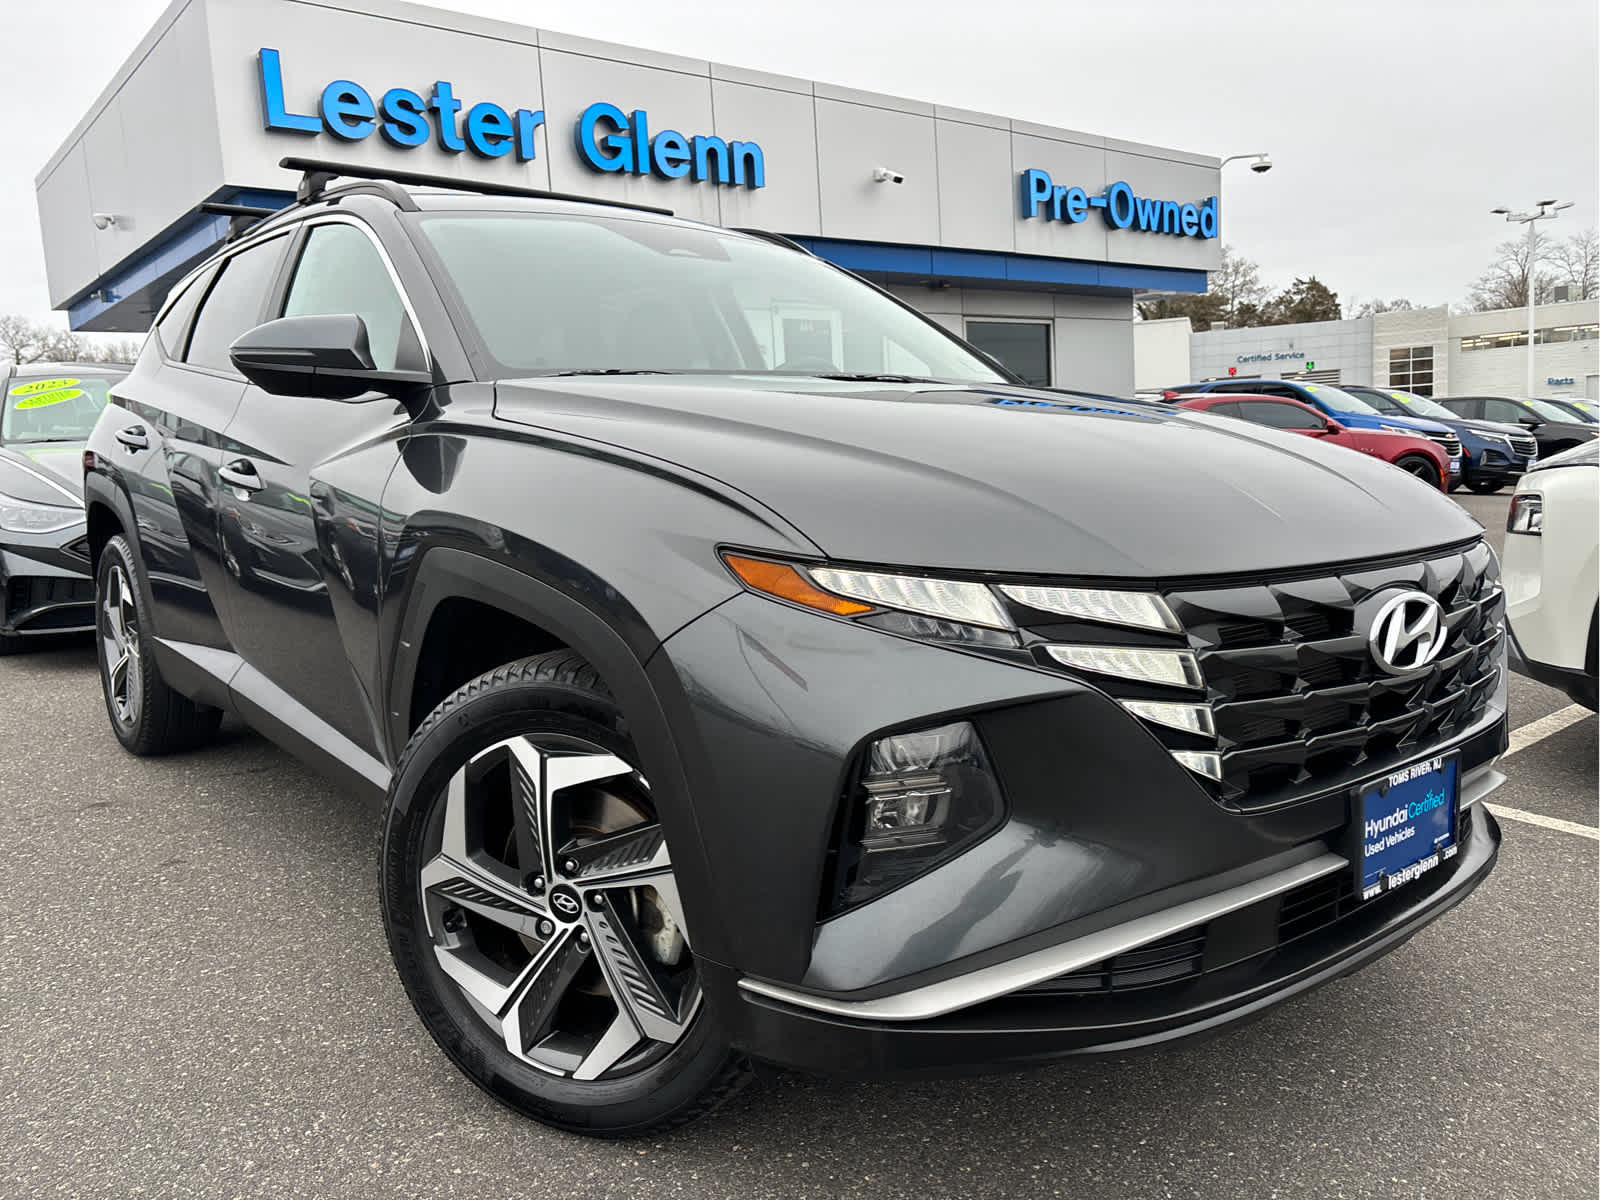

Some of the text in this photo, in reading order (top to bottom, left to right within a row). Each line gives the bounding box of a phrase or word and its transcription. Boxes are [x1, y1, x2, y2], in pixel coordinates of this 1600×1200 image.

[256, 47, 766, 190] Lester Glenn
[1021, 168, 1218, 240] Pre-Owned
[1237, 351, 1305, 363] Certified Service
[1547, 377, 1575, 386] Parts
[1388, 771, 1409, 788] TOMS
[1432, 757, 1443, 770] NJ
[1364, 837, 1385, 858] Used
[1385, 825, 1416, 846] Vehicles
[1388, 854, 1439, 890] lesterglenn
